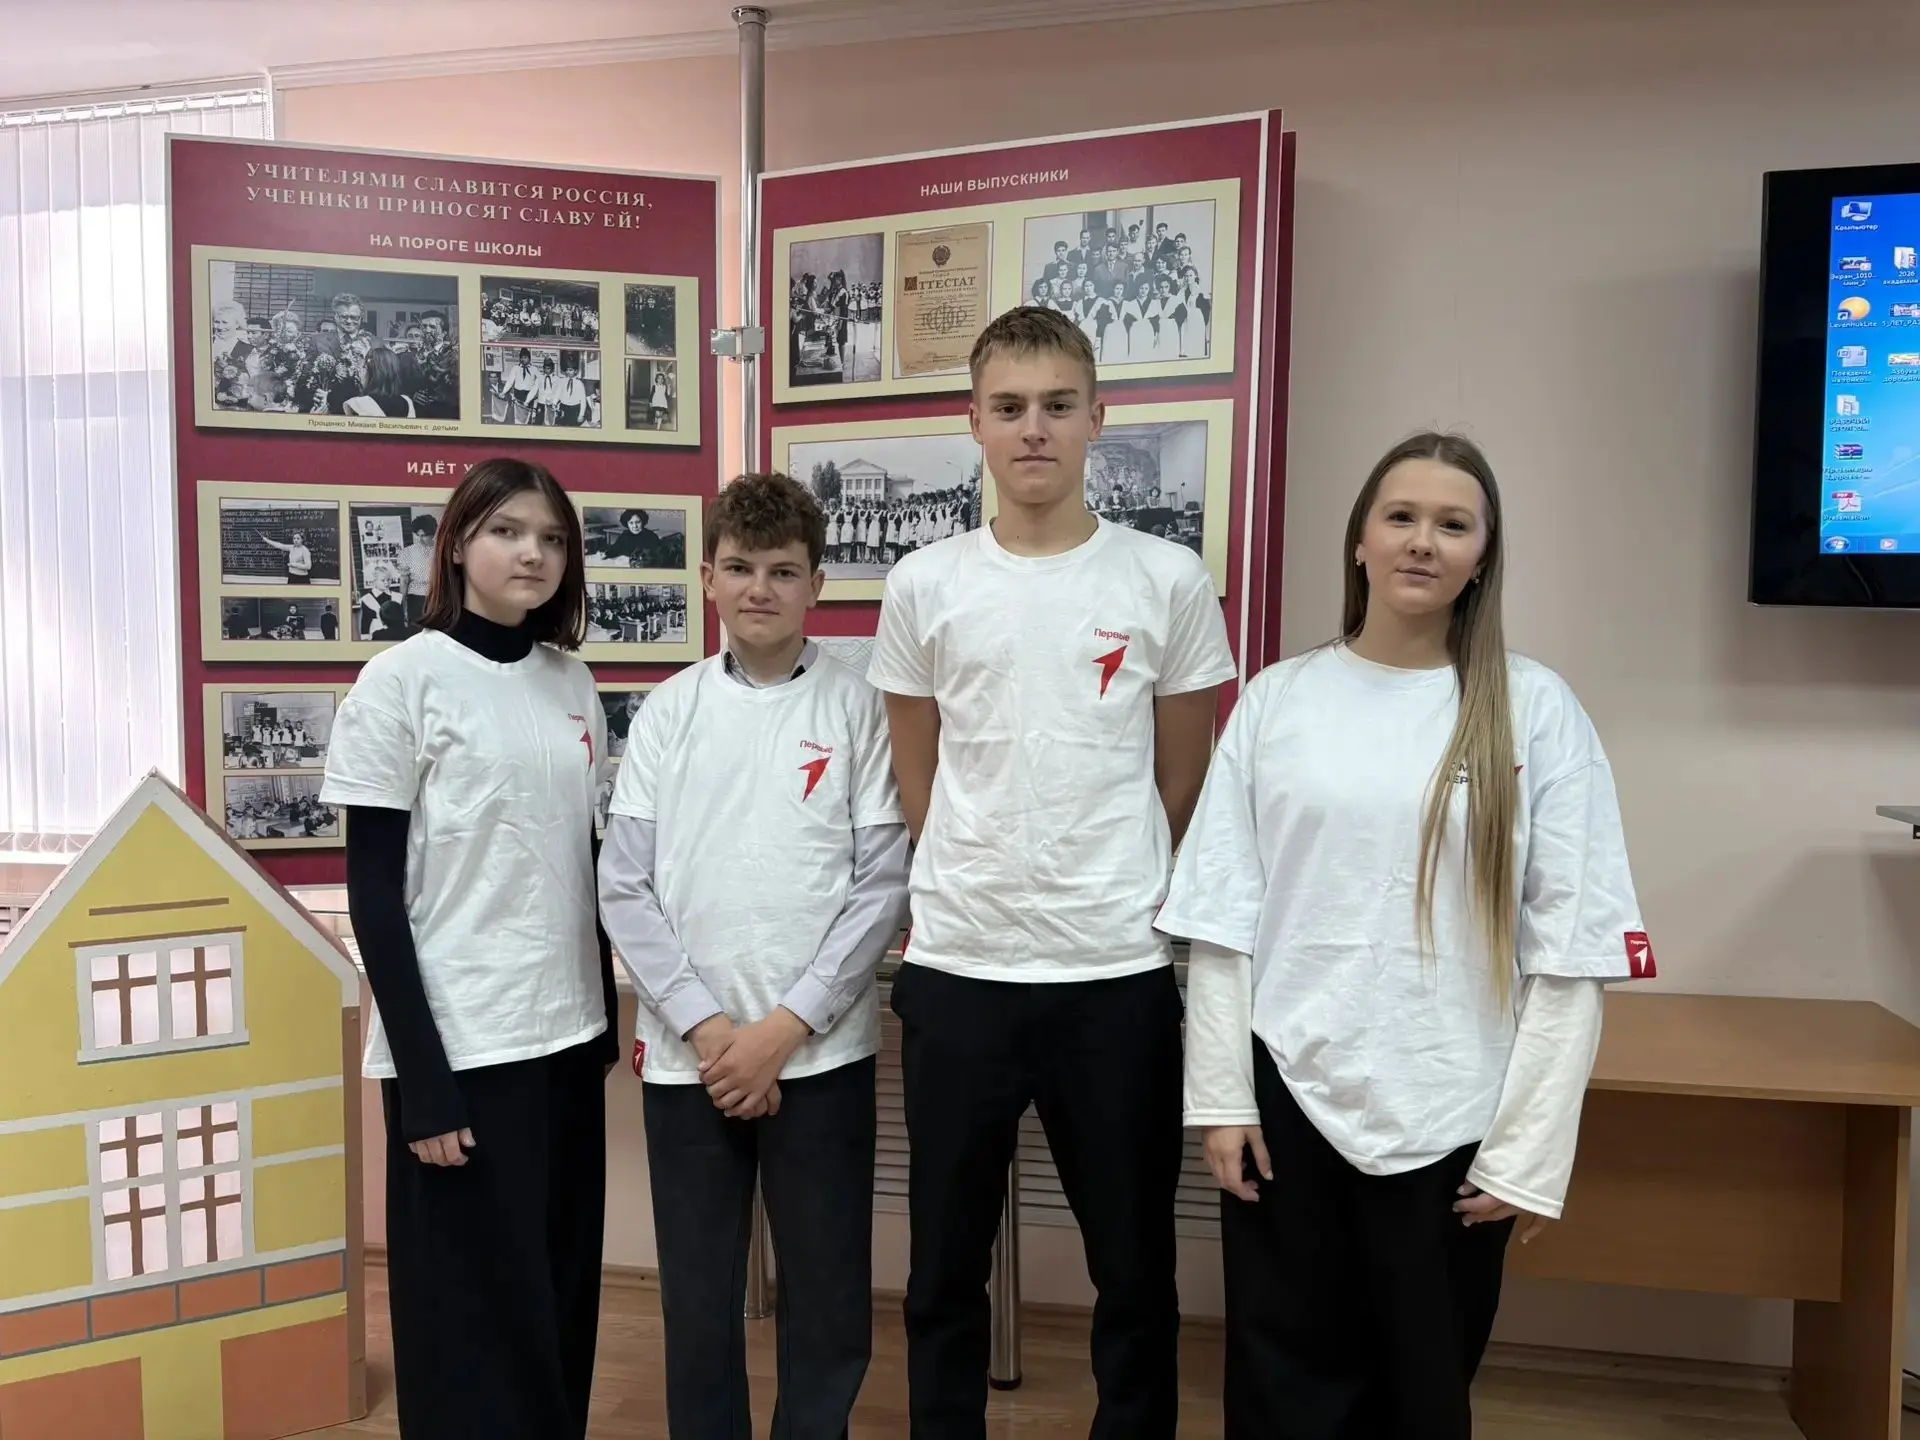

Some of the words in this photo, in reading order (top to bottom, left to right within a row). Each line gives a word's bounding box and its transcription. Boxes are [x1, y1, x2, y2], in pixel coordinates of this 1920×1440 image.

[246, 162, 405, 188] УЧИТЕЛЯМИ
[414, 175, 544, 199] СЛАВИТСЯ
[552, 186, 653, 210] РОССИЯ,
[920, 181, 963, 197] НАШИ
[967, 169, 1069, 191] ВЫПУСКНИКИ
[246, 186, 369, 209] УЧЕНИКИ
[378, 197, 512, 220] ПРИНОСЯТ
[519, 207, 596, 226] СЛАВУ
[603, 210, 641, 229] ЕЙ!
[370, 233, 393, 247] НА
[400, 236, 469, 252] ПОРОГЕ
[474, 241, 542, 257] ШКОЛЫ
[406, 460, 457, 476] ИДЁТ
[1094, 627, 1130, 641] Первые
